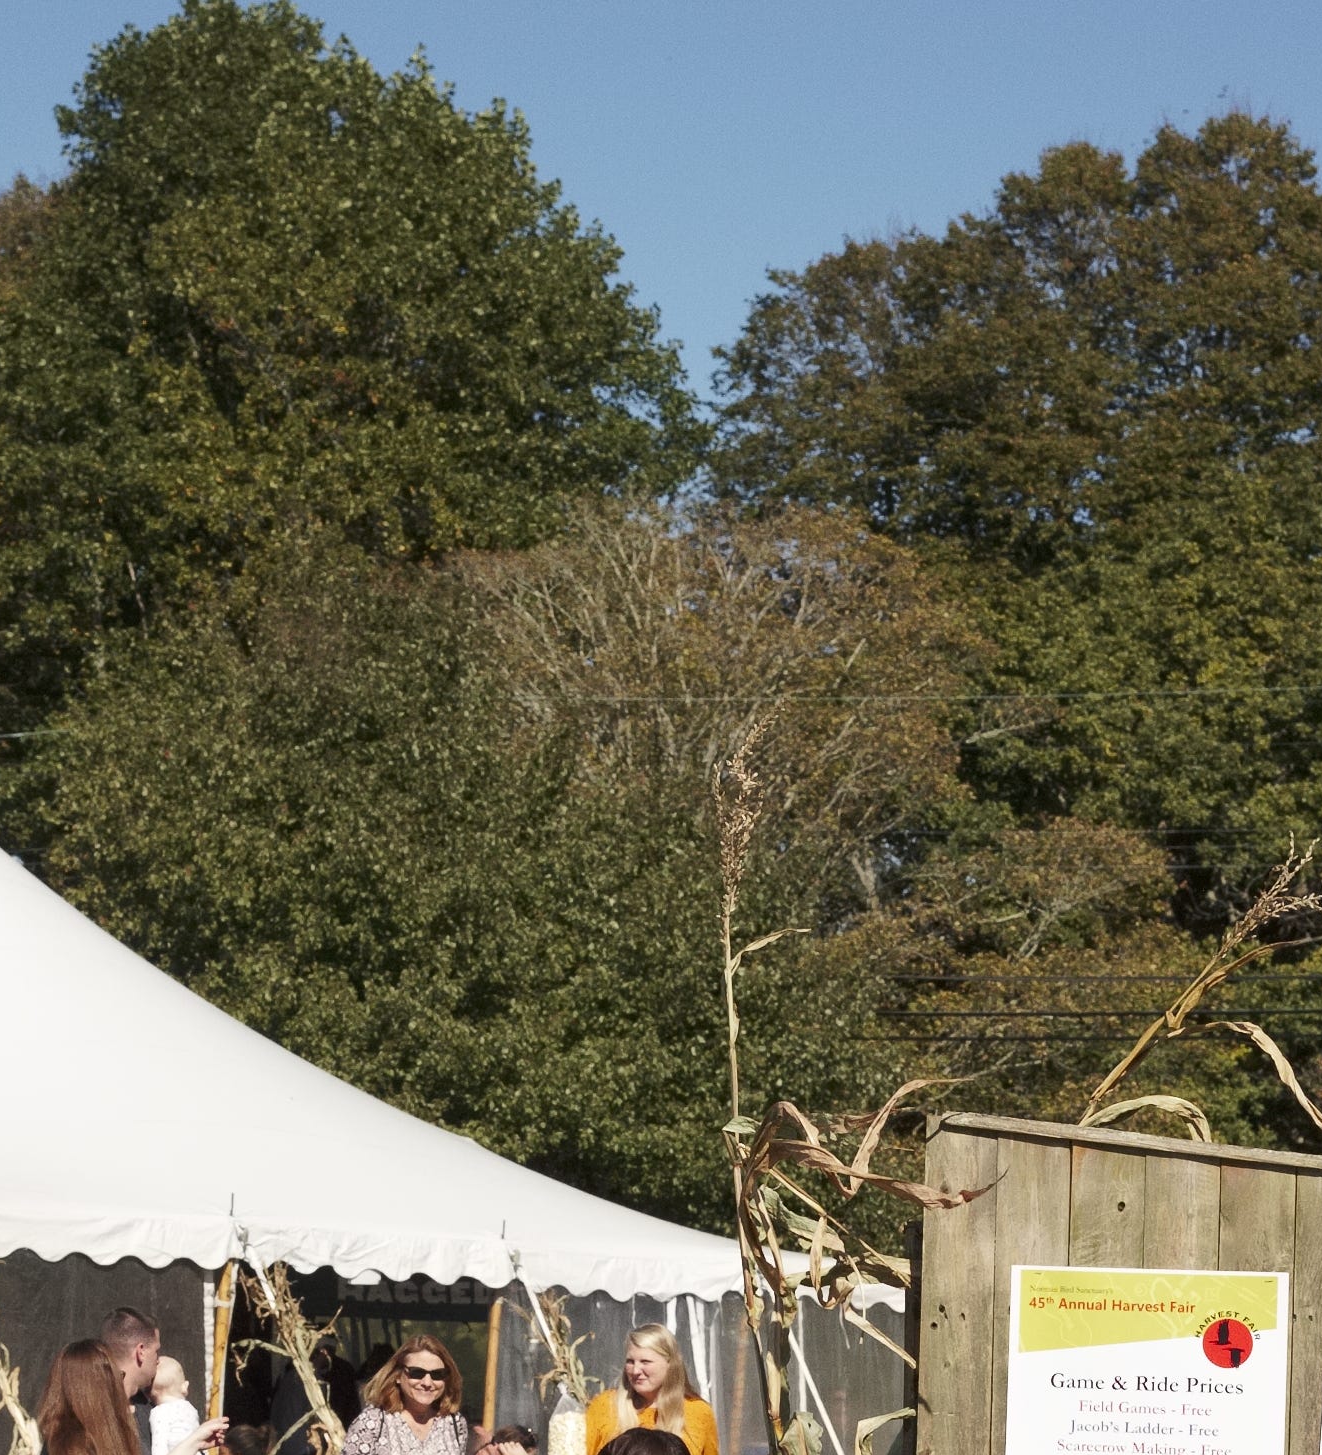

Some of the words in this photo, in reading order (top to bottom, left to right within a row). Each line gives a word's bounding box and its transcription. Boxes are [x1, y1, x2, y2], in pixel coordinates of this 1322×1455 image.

[1059, 1297, 1107, 1311] Annual
[1112, 1300, 1165, 1313] Harvest
[1170, 1301, 1195, 1314] Fair
[1195, 1310, 1239, 1338] HARVEST
[1243, 1316, 1261, 1340] FAIR
[1050, 1372, 1105, 1390] Game
[1111, 1376, 1127, 1391] &
[1136, 1375, 1179, 1393] Ride
[1187, 1378, 1244, 1395] Prices
[1079, 1400, 1113, 1414] Field
[1118, 1402, 1167, 1415] Games
[1181, 1404, 1213, 1417] Free
[1069, 1420, 1119, 1435] Jacob's
[1125, 1422, 1175, 1436] Ladder
[1189, 1424, 1219, 1438] Free
[1057, 1438, 1127, 1453] Scarecrow
